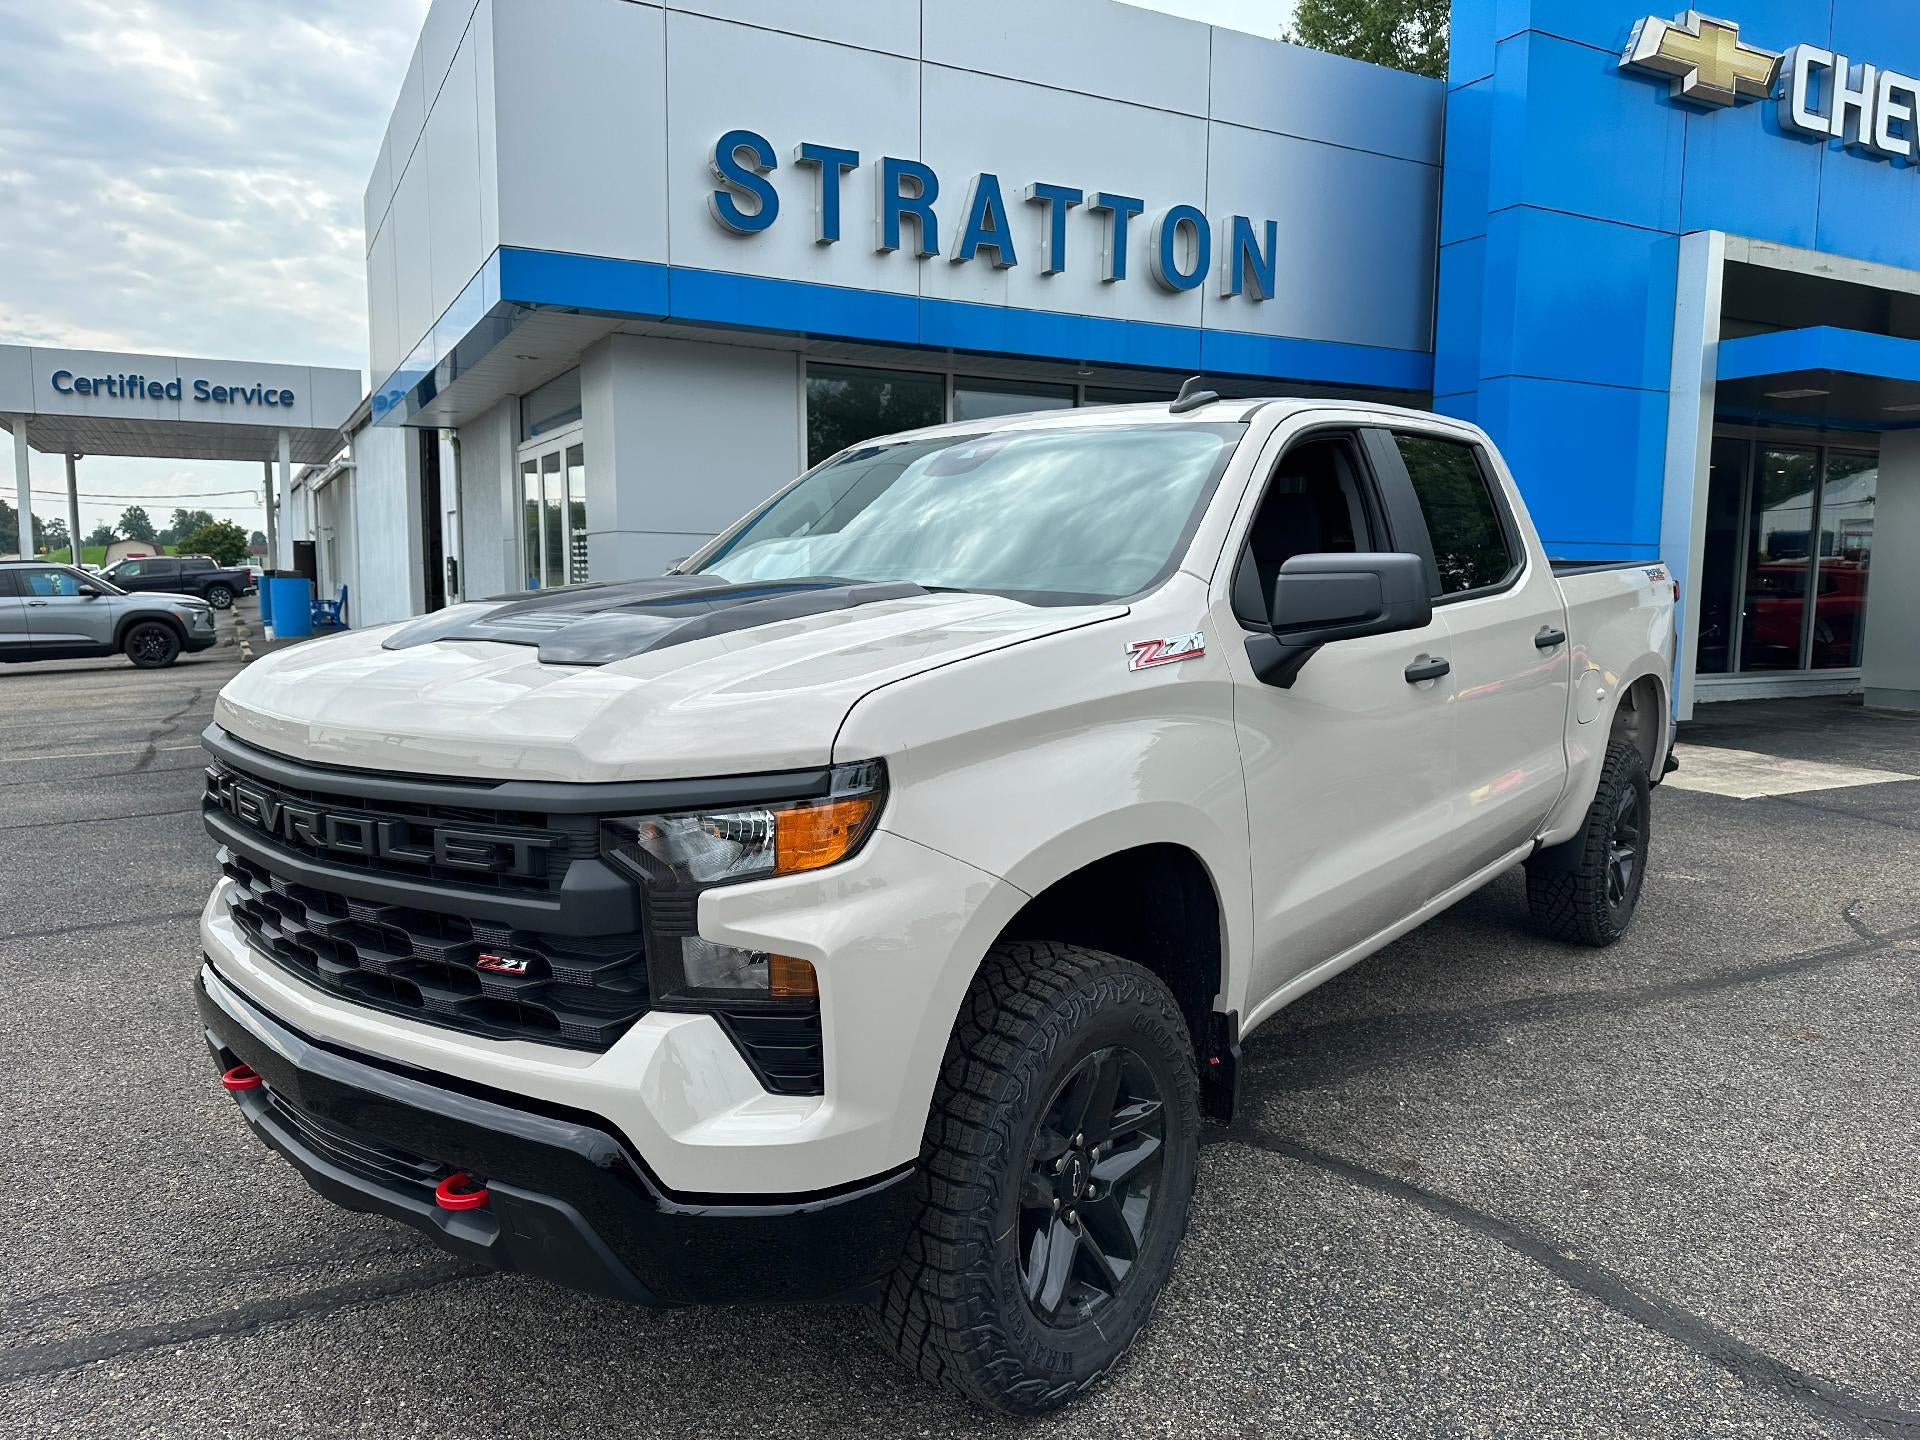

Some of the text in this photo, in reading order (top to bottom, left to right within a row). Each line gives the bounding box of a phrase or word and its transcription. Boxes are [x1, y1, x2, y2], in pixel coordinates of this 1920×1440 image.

[1777, 43, 1920, 166] CHE
[707, 129, 1277, 300] STRATTON
[51, 370, 295, 407] Certified Service
[1124, 631, 1206, 672] Z71
[204, 767, 566, 876] CHEVROLET
